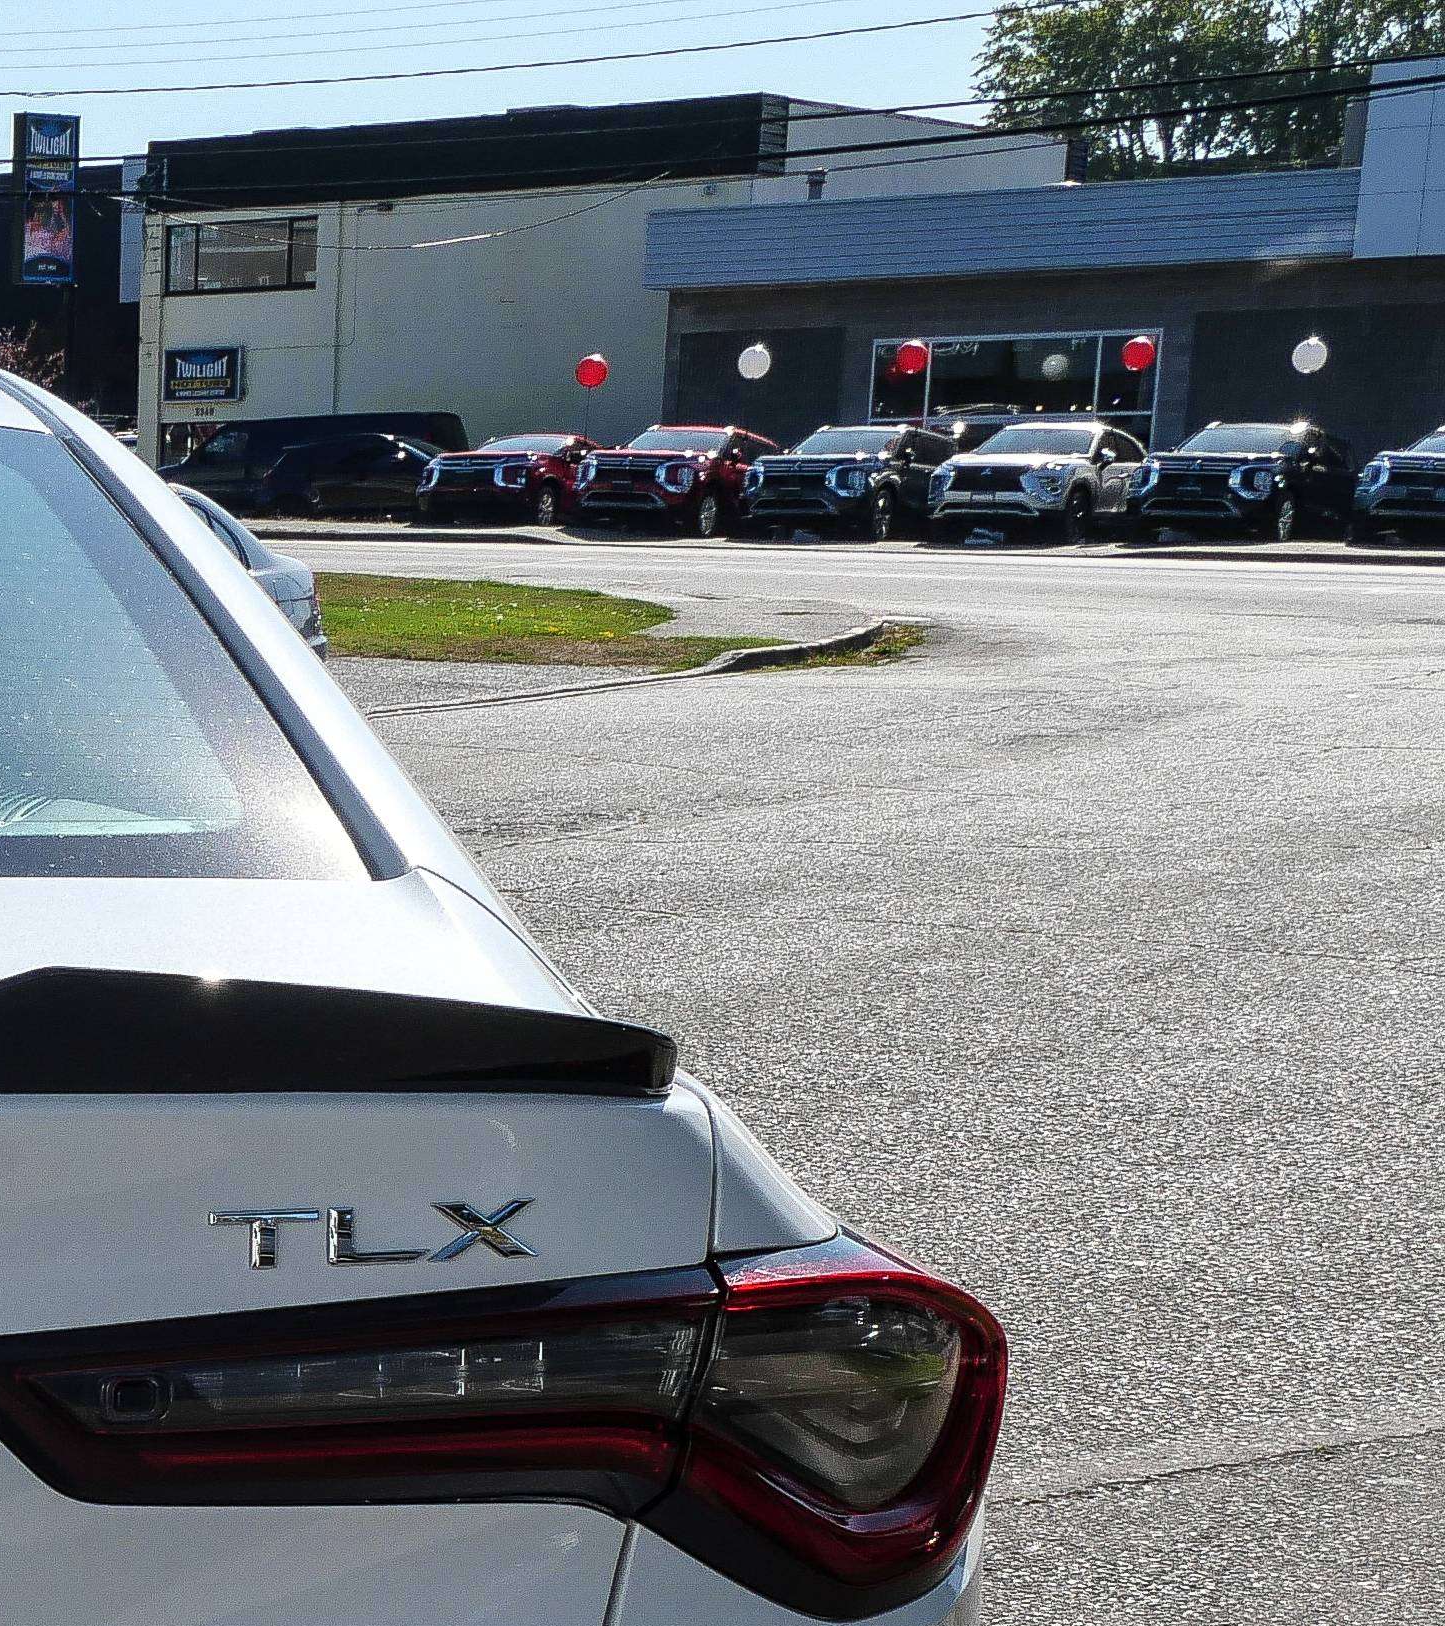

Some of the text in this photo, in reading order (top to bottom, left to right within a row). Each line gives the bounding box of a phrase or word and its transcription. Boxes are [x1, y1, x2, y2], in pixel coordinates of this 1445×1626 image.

[30, 126, 72, 155] TWILIGHT
[175, 355, 228, 378] TWILIGHT
[208, 1197, 538, 1270] TLX
